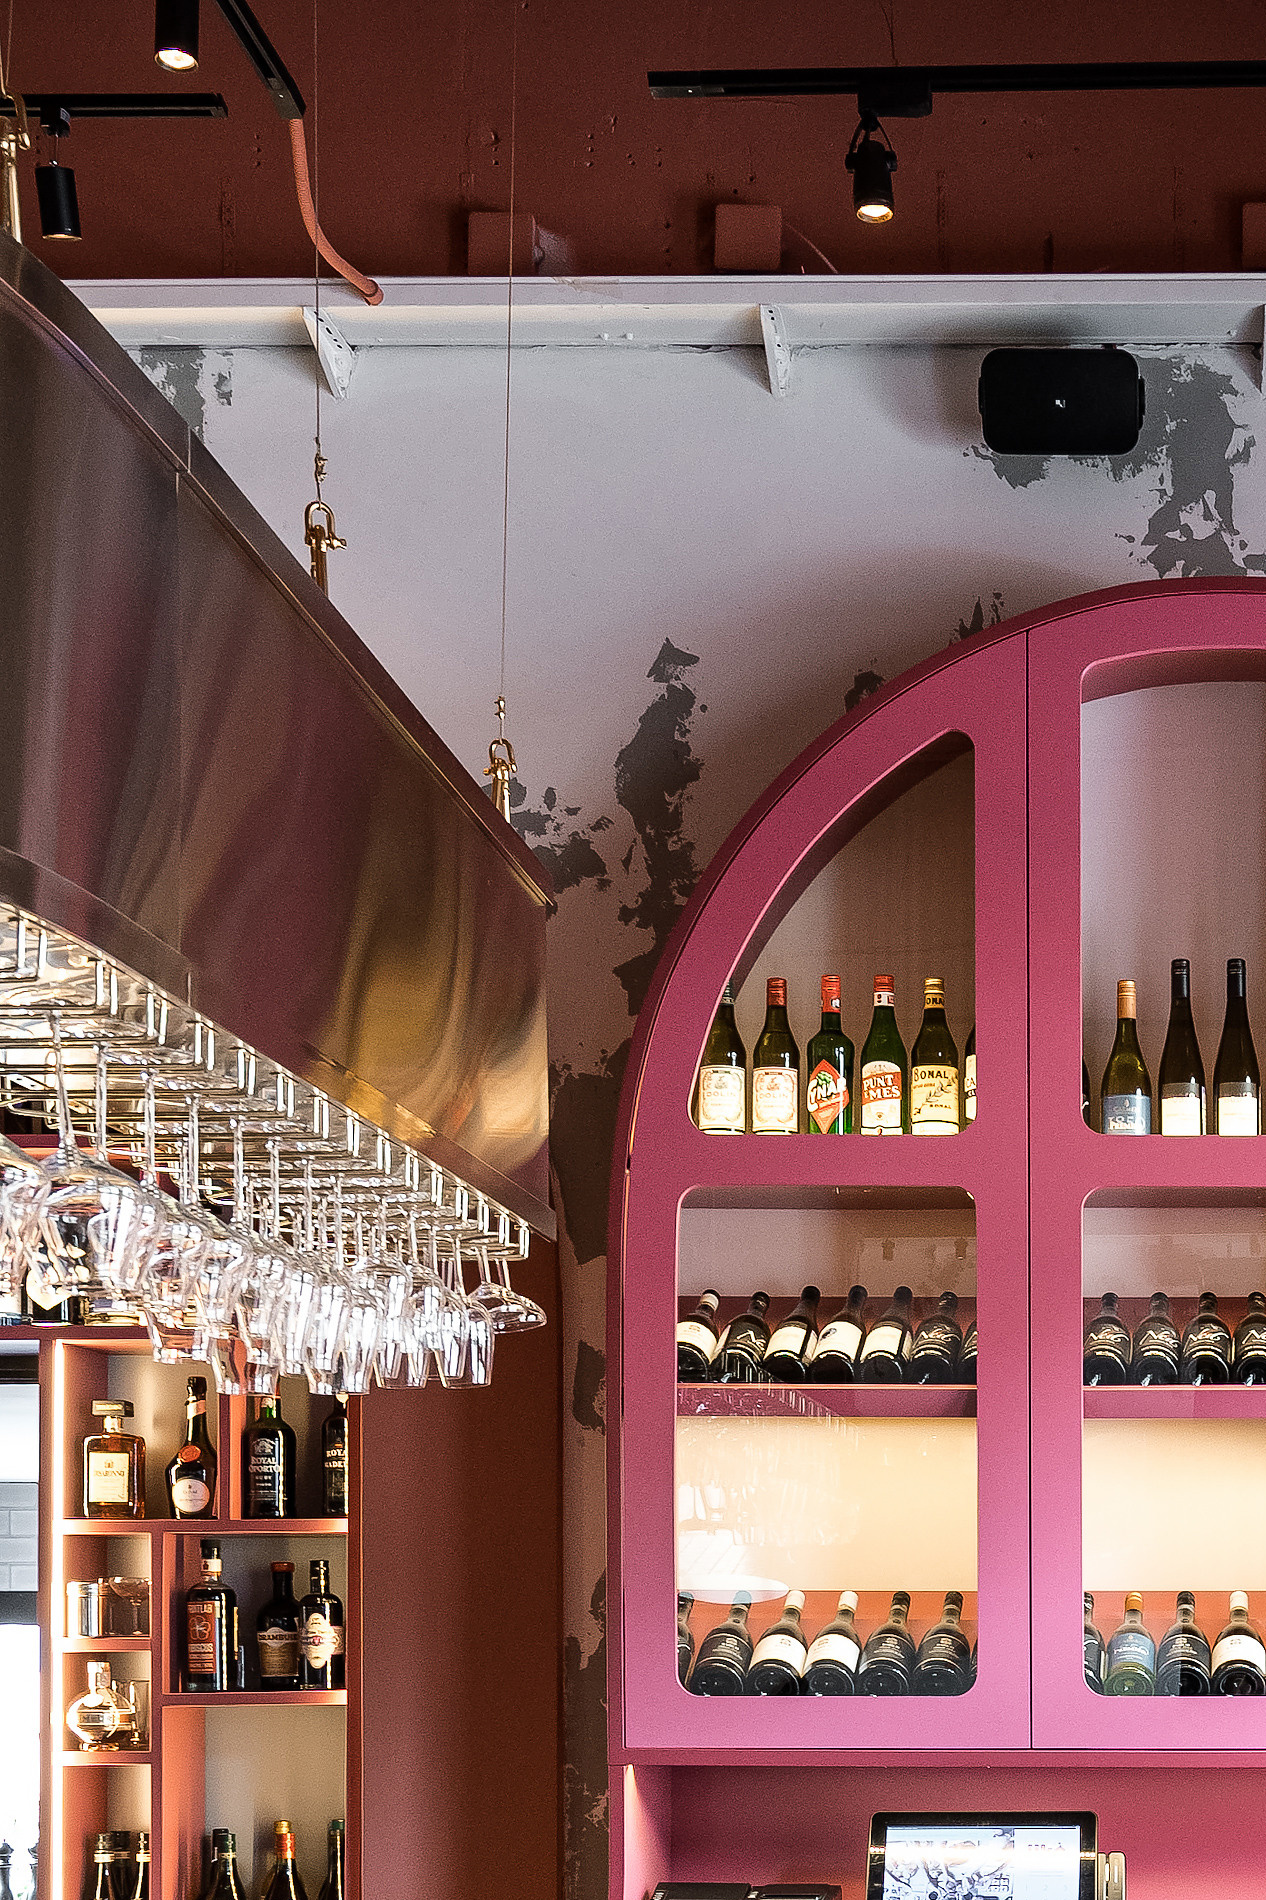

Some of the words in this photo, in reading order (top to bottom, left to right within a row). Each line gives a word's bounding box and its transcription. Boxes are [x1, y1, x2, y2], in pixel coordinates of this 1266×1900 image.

[863, 1074, 894, 1090] PUNT
[913, 1068, 949, 1082] BONAL
[868, 1086, 901, 1100] MES
[326, 1449, 346, 1457] ROYA
[251, 1456, 276, 1465] ROYAL
